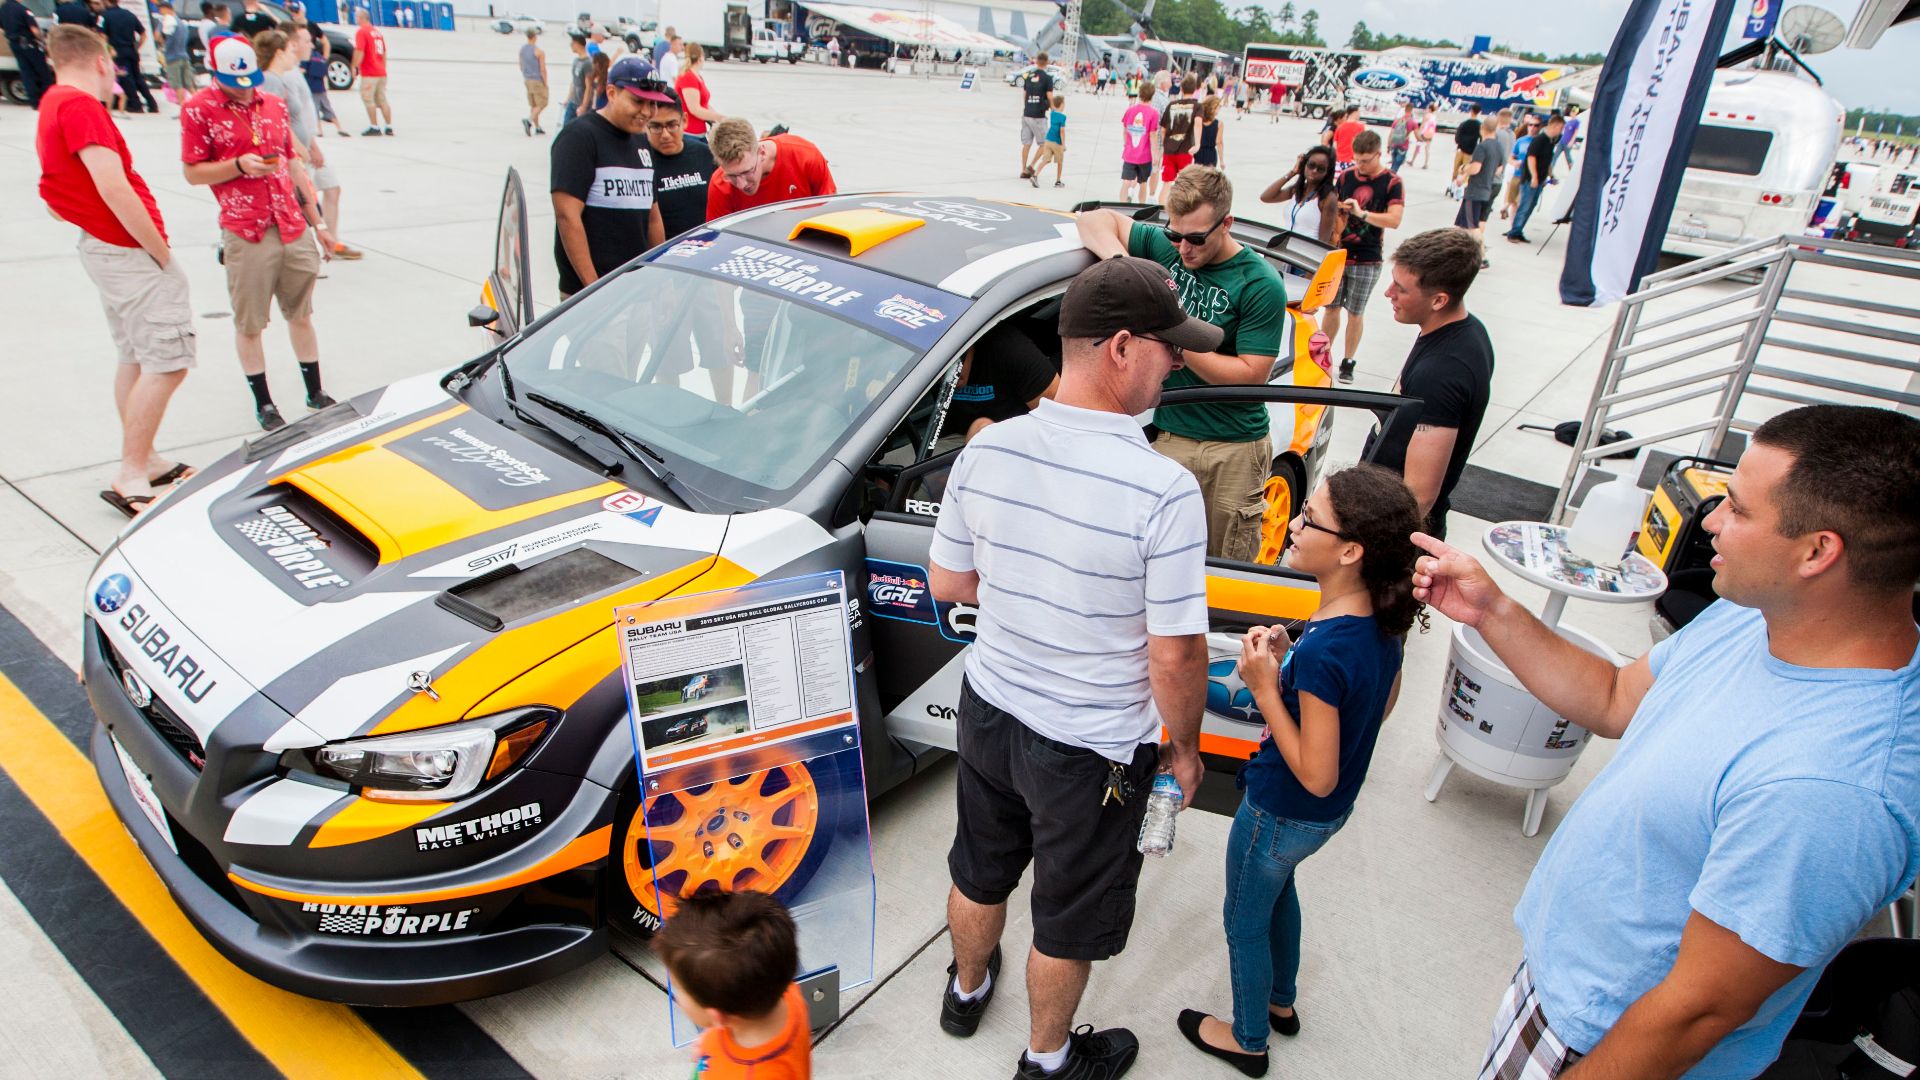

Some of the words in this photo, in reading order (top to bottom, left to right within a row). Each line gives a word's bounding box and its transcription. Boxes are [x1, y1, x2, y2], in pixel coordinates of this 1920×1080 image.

[1361, 71, 1399, 89] Ford
[861, 202, 997, 233] SUBARU
[731, 245, 804, 269] ROYAL
[751, 266, 864, 306] PURPLE
[449, 427, 498, 454] Vermont
[928, 410, 946, 450] Vermont
[260, 505, 318, 541] ROYAL
[522, 534, 560, 549] SUBARU
[561, 522, 600, 536] TECNICA
[524, 526, 603, 552] INTERNATIONAL
[877, 584, 925, 604] GRC
[627, 621, 681, 637] SUBARU
[120, 604, 217, 703] SUBARU
[416, 802, 541, 843] METHOD
[419, 838, 464, 851] RACE
[474, 816, 542, 841] WHEELS
